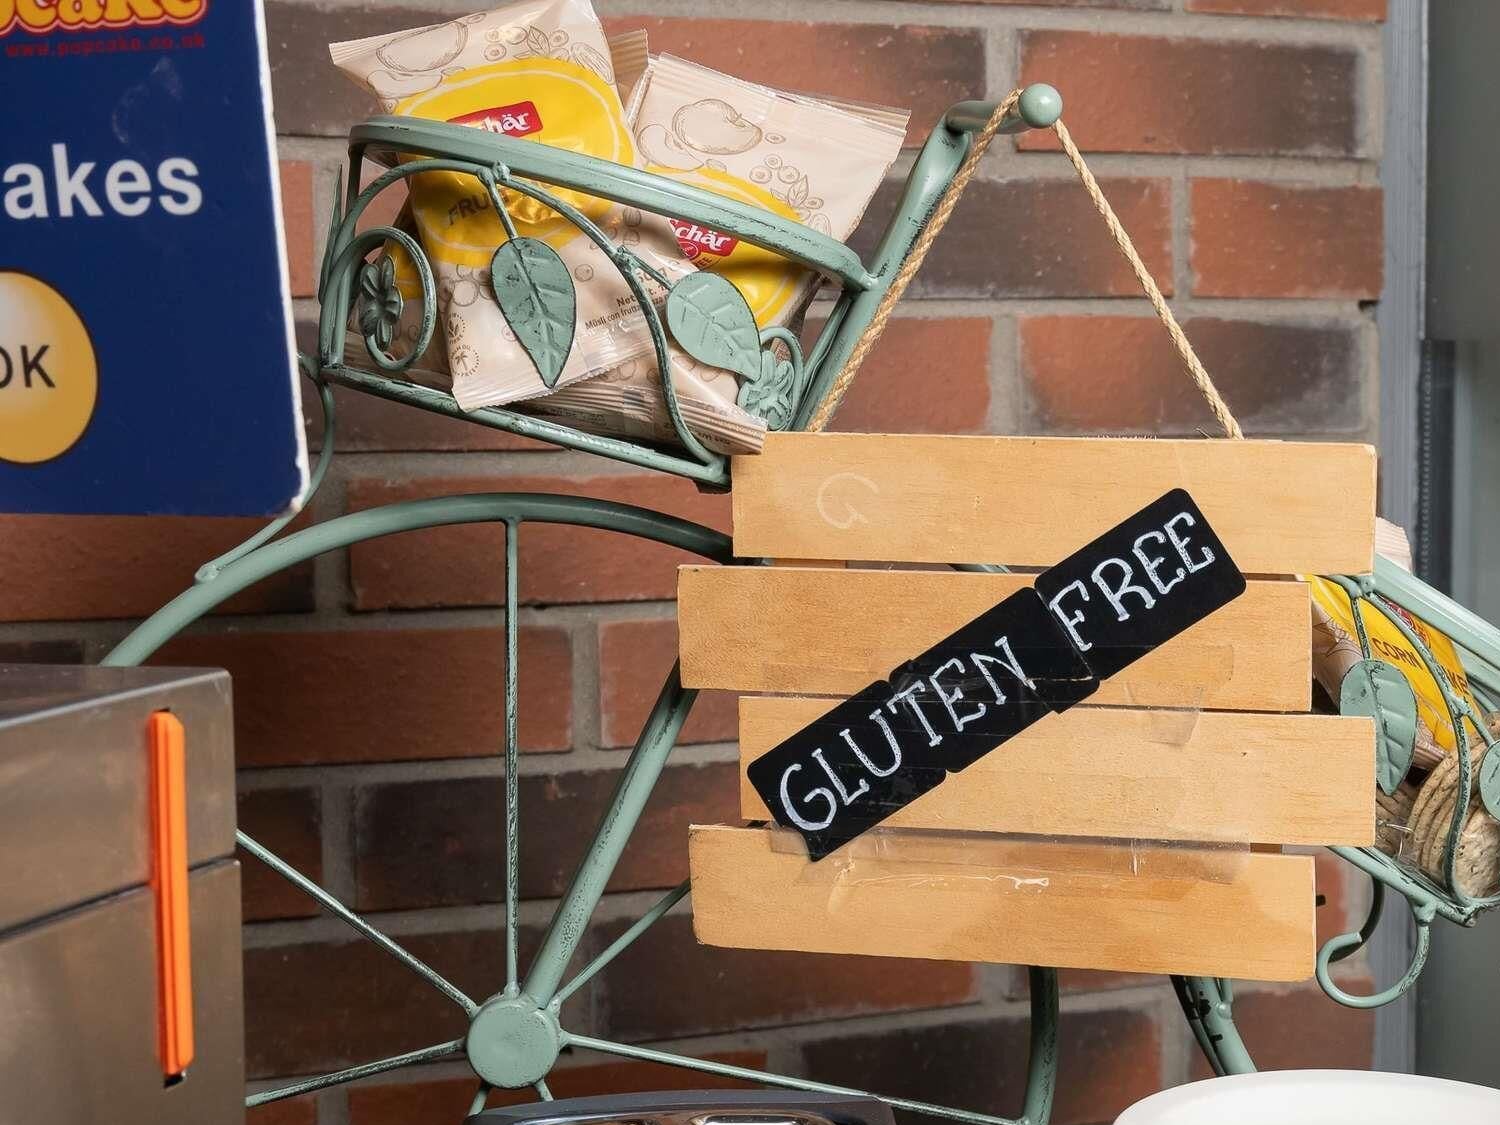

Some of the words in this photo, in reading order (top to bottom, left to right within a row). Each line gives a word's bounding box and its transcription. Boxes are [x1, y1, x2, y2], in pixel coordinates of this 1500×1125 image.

[779, 635, 1036, 832] GLUTEN
[1048, 511, 1216, 651] FREE
[1372, 637, 1423, 671] CORN
